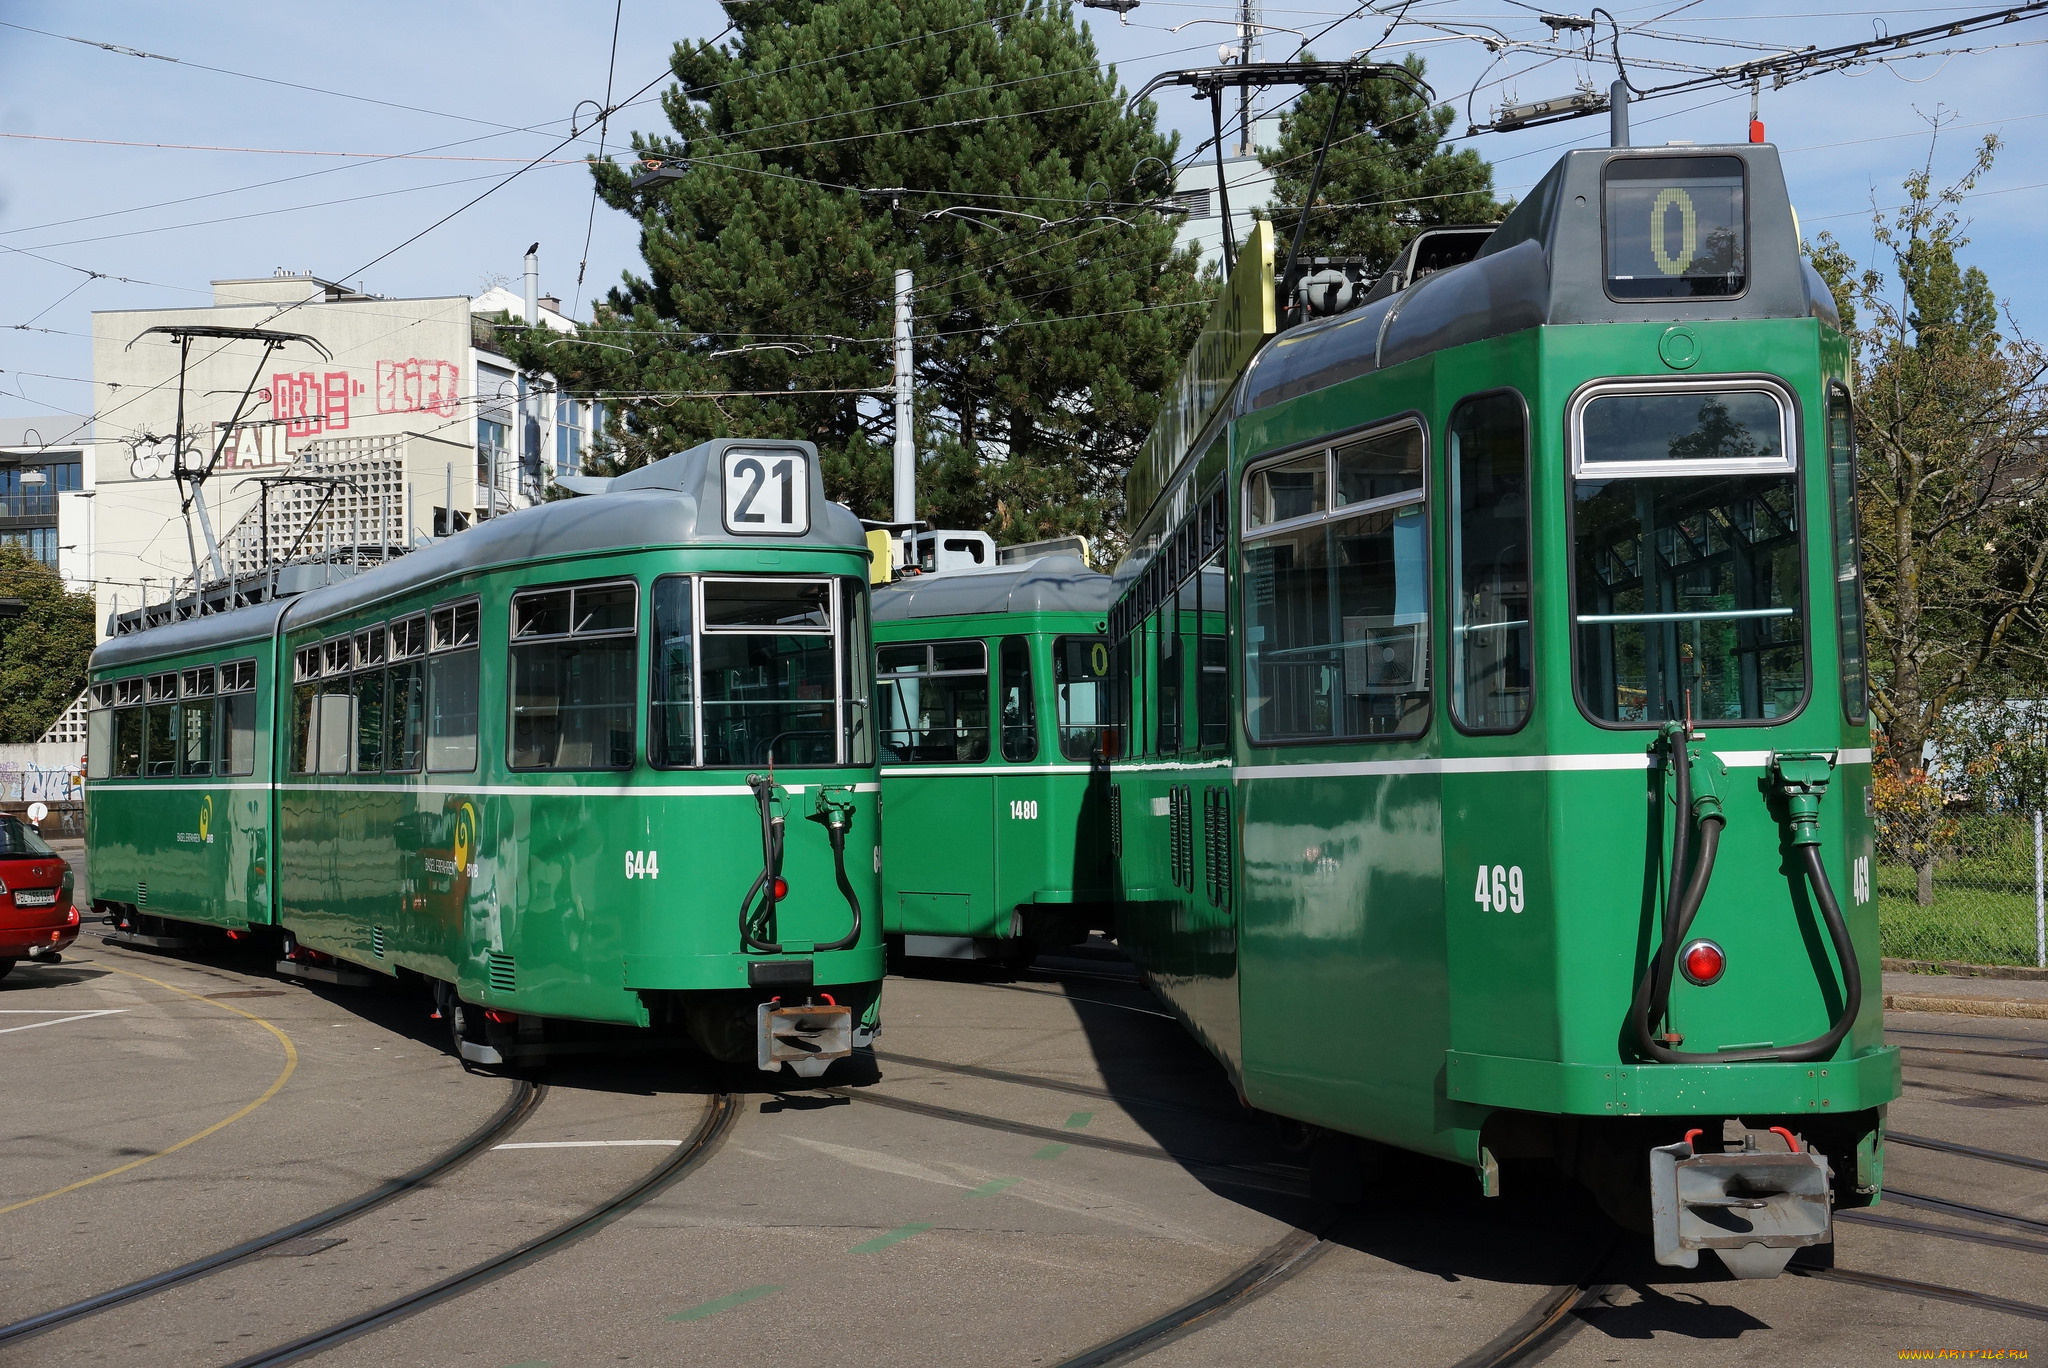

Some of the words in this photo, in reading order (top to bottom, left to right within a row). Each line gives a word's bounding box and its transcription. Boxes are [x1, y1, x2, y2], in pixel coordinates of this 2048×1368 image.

[1651, 188, 1697, 275] 0
[212, 421, 297, 469] FAIL
[733, 457, 793, 524] 21
[1091, 642, 1108, 676] 0
[1010, 800, 1038, 820] 1480
[466, 863, 479, 878] BVB
[625, 850, 659, 879] 644
[1853, 855, 1870, 907] 469
[1474, 864, 1525, 914] 469
